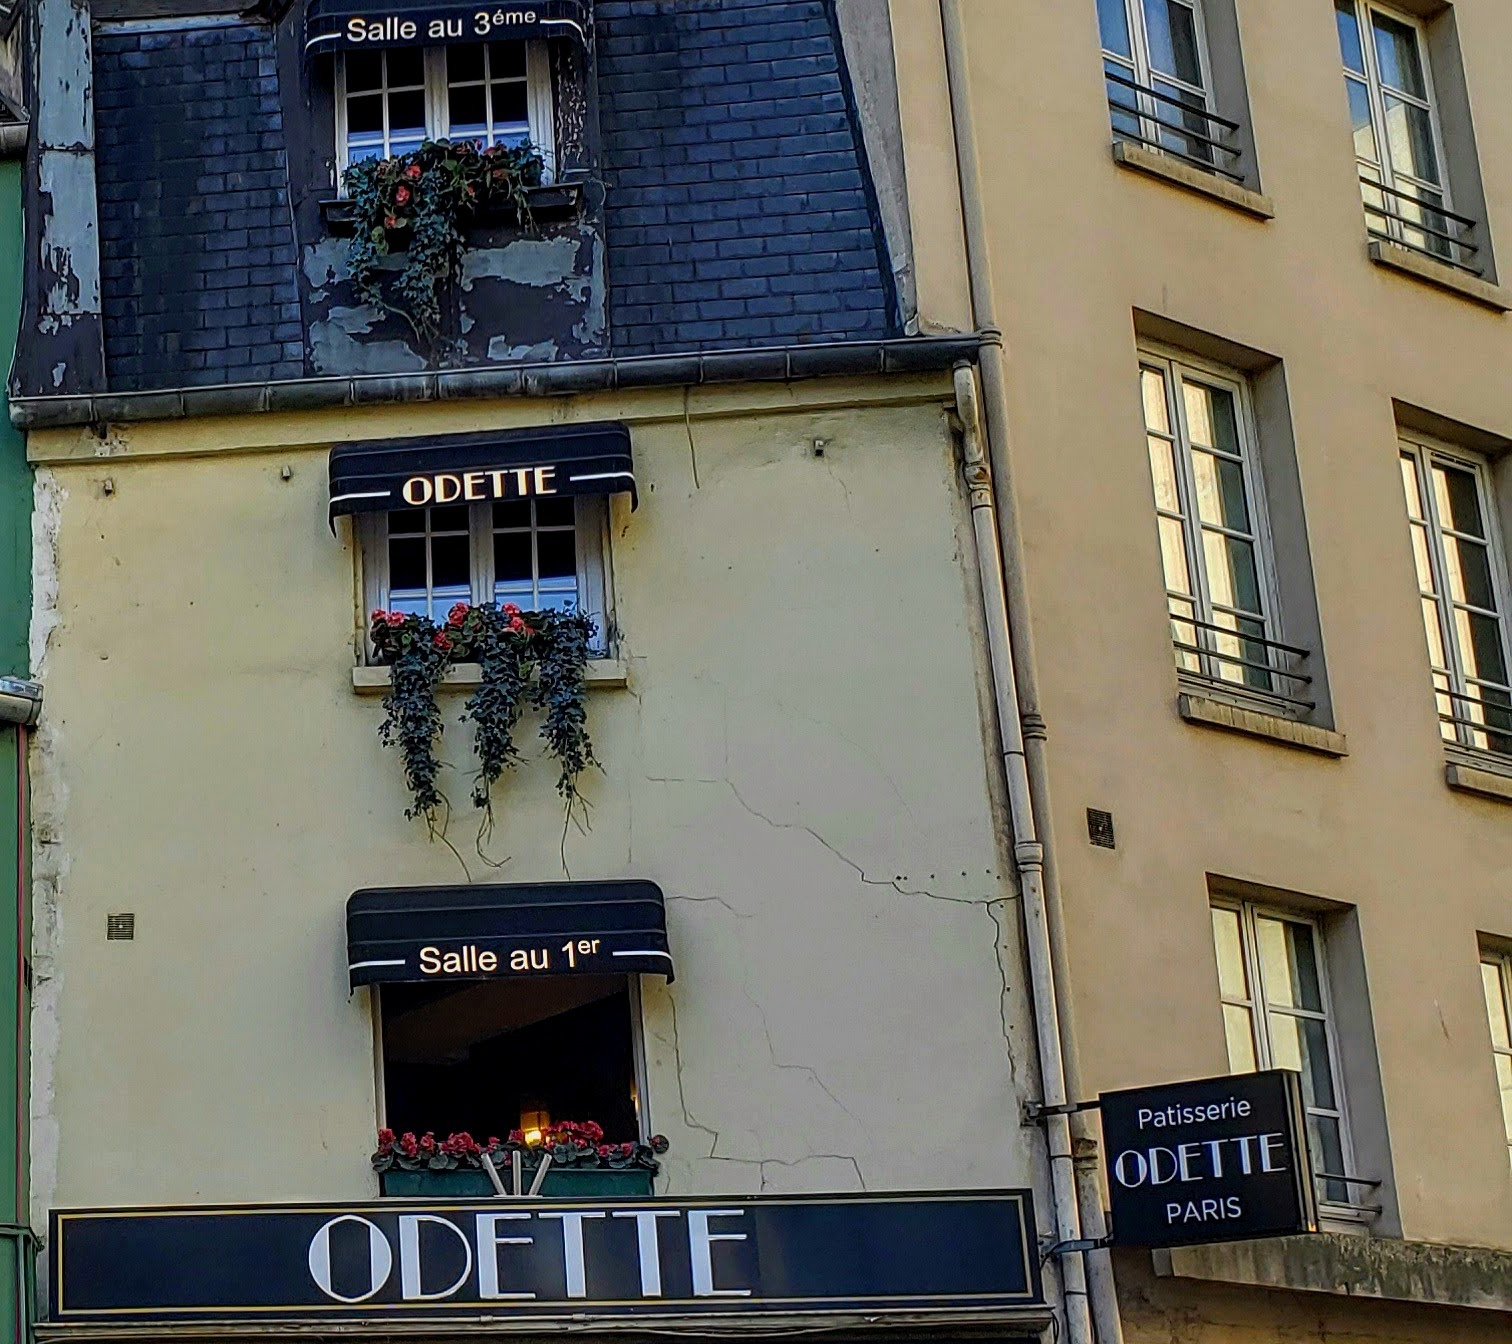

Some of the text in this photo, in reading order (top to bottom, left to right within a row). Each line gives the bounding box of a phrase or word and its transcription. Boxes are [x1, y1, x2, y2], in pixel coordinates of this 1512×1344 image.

[347, 17, 417, 42] Salle
[428, 17, 463, 38] au
[402, 466, 558, 505] ODETTE
[419, 937, 600, 974] Salle au 1er
[1138, 1096, 1251, 1130] Patisserie
[1115, 1132, 1287, 1188] ODETTE
[1166, 1196, 1242, 1224] PARIS
[308, 1209, 752, 1304] ODETTE
